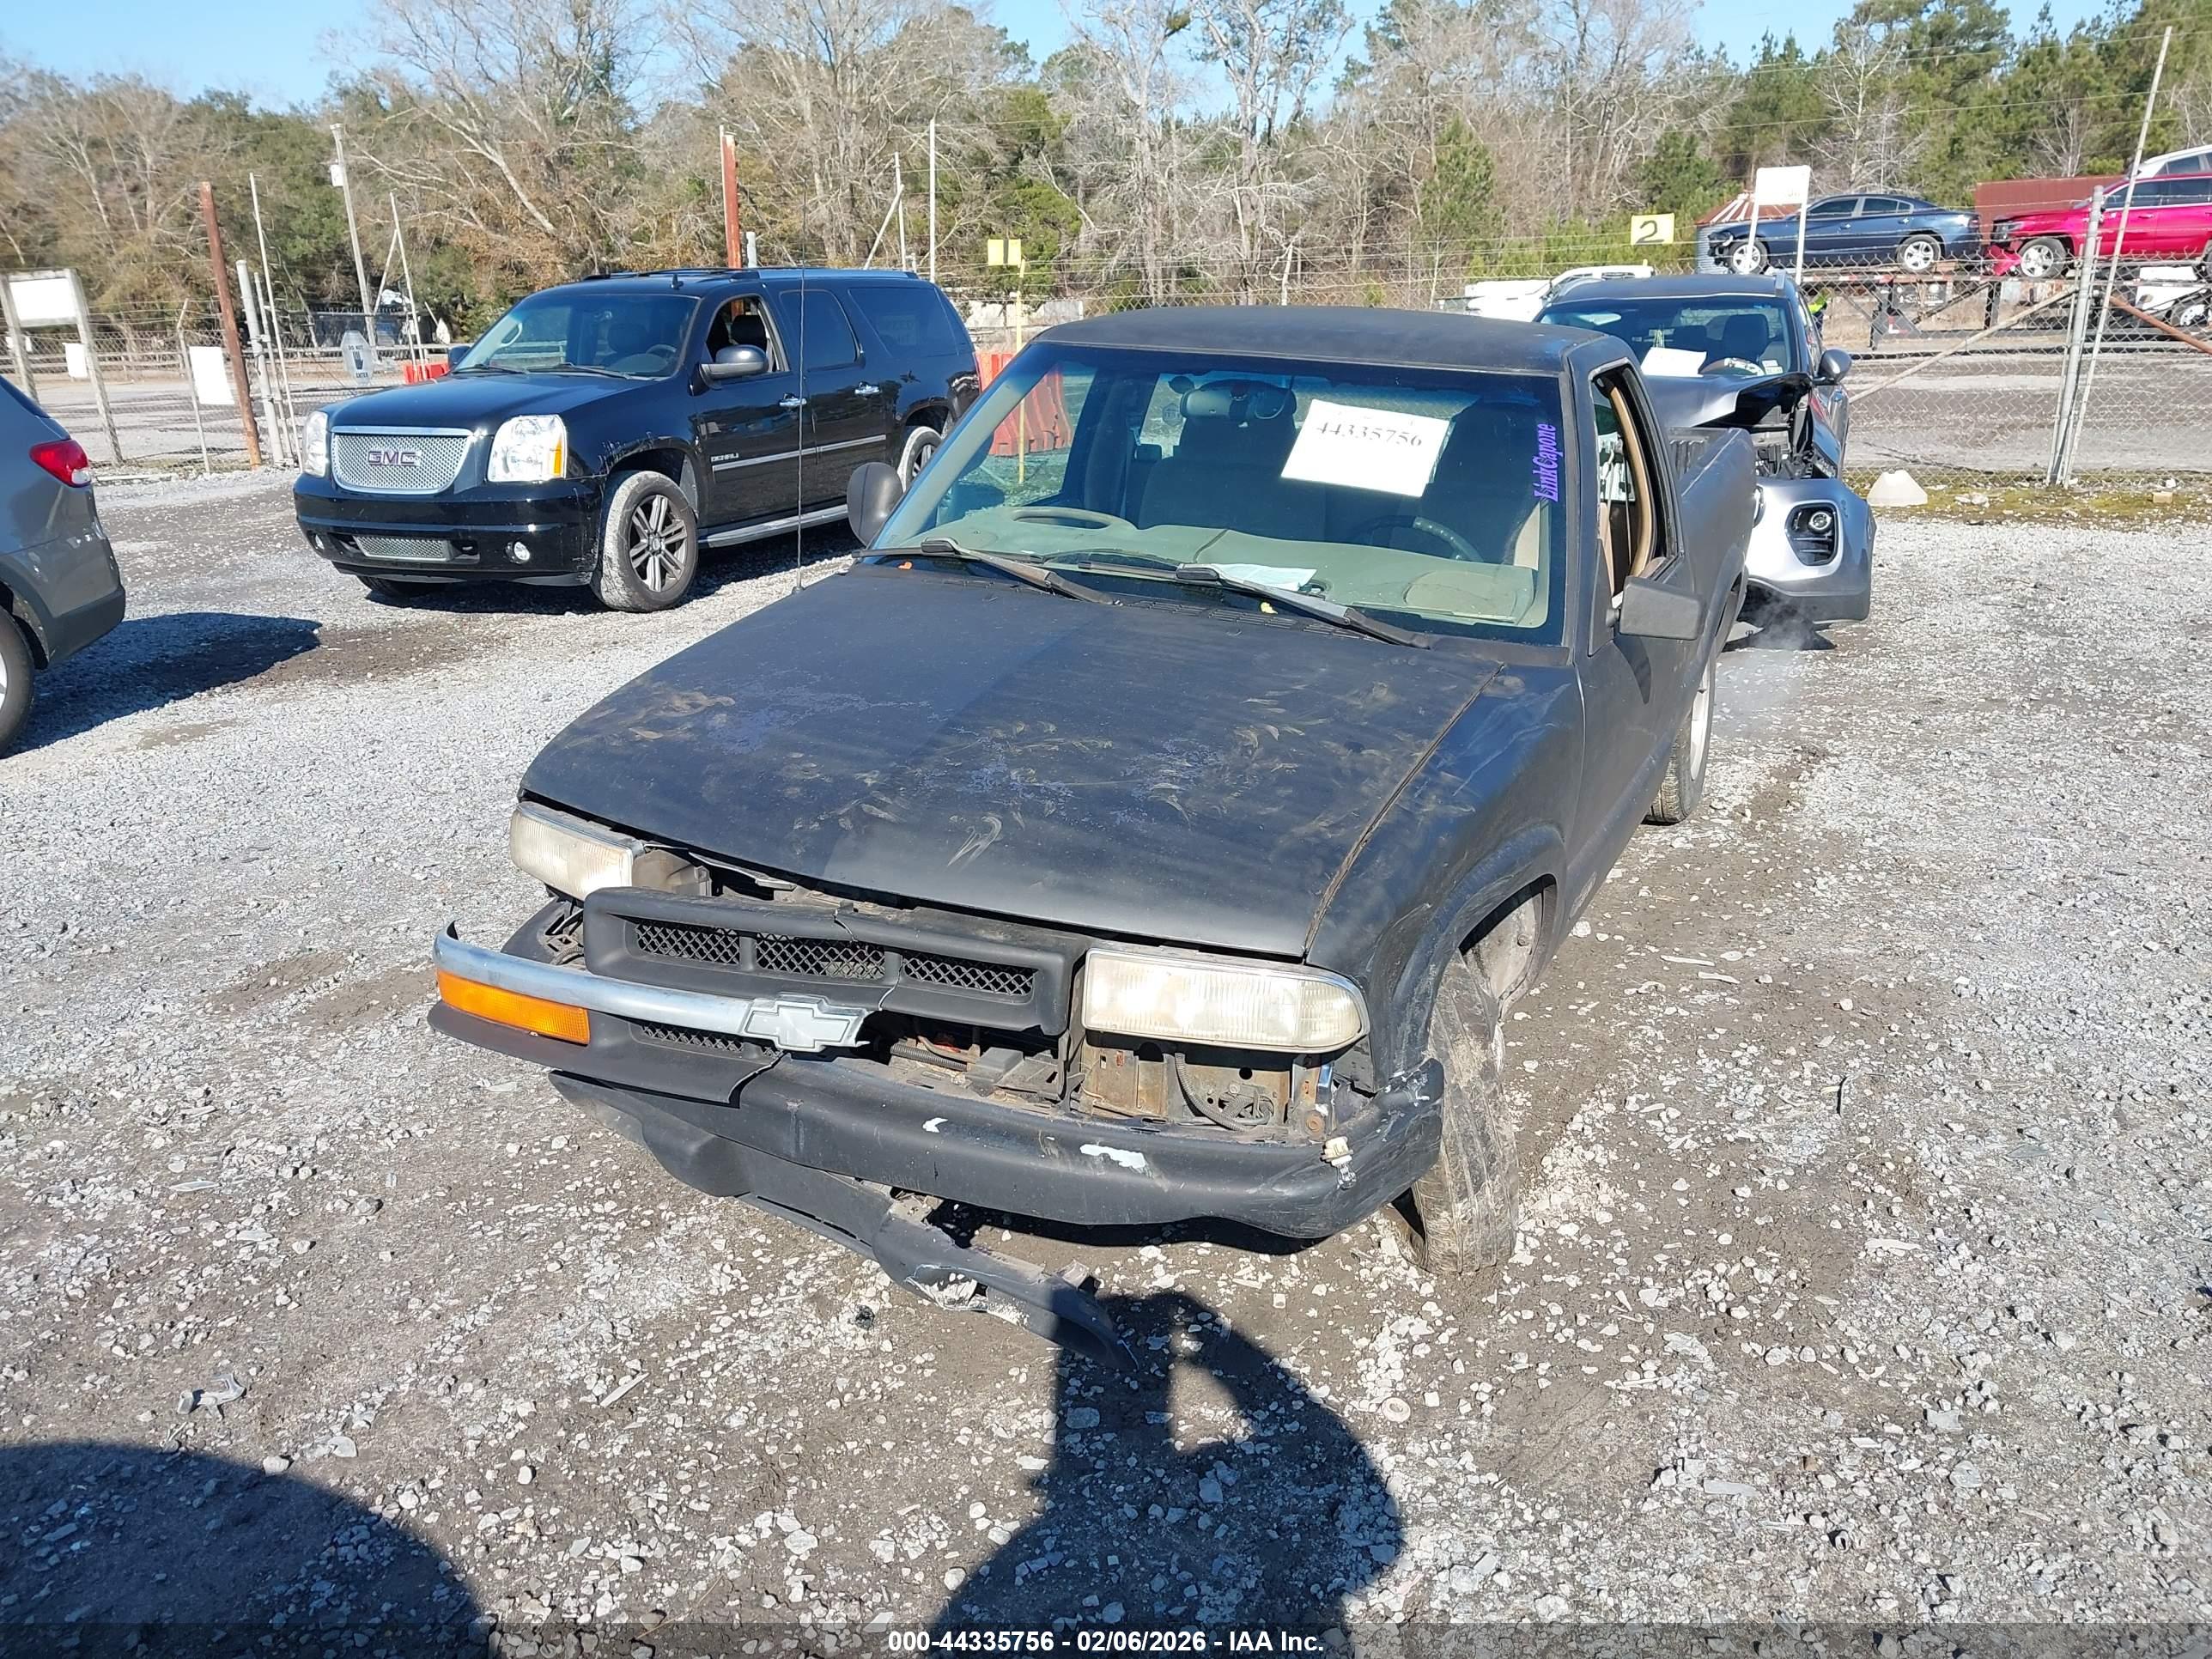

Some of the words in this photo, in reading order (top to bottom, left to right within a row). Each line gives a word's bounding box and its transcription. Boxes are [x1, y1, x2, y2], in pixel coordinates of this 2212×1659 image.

[1636, 220, 1665, 244] 2
[1316, 421, 1423, 447] 44335756
[368, 450, 418, 467] GMC
[710, 453, 739, 463] DENALI
